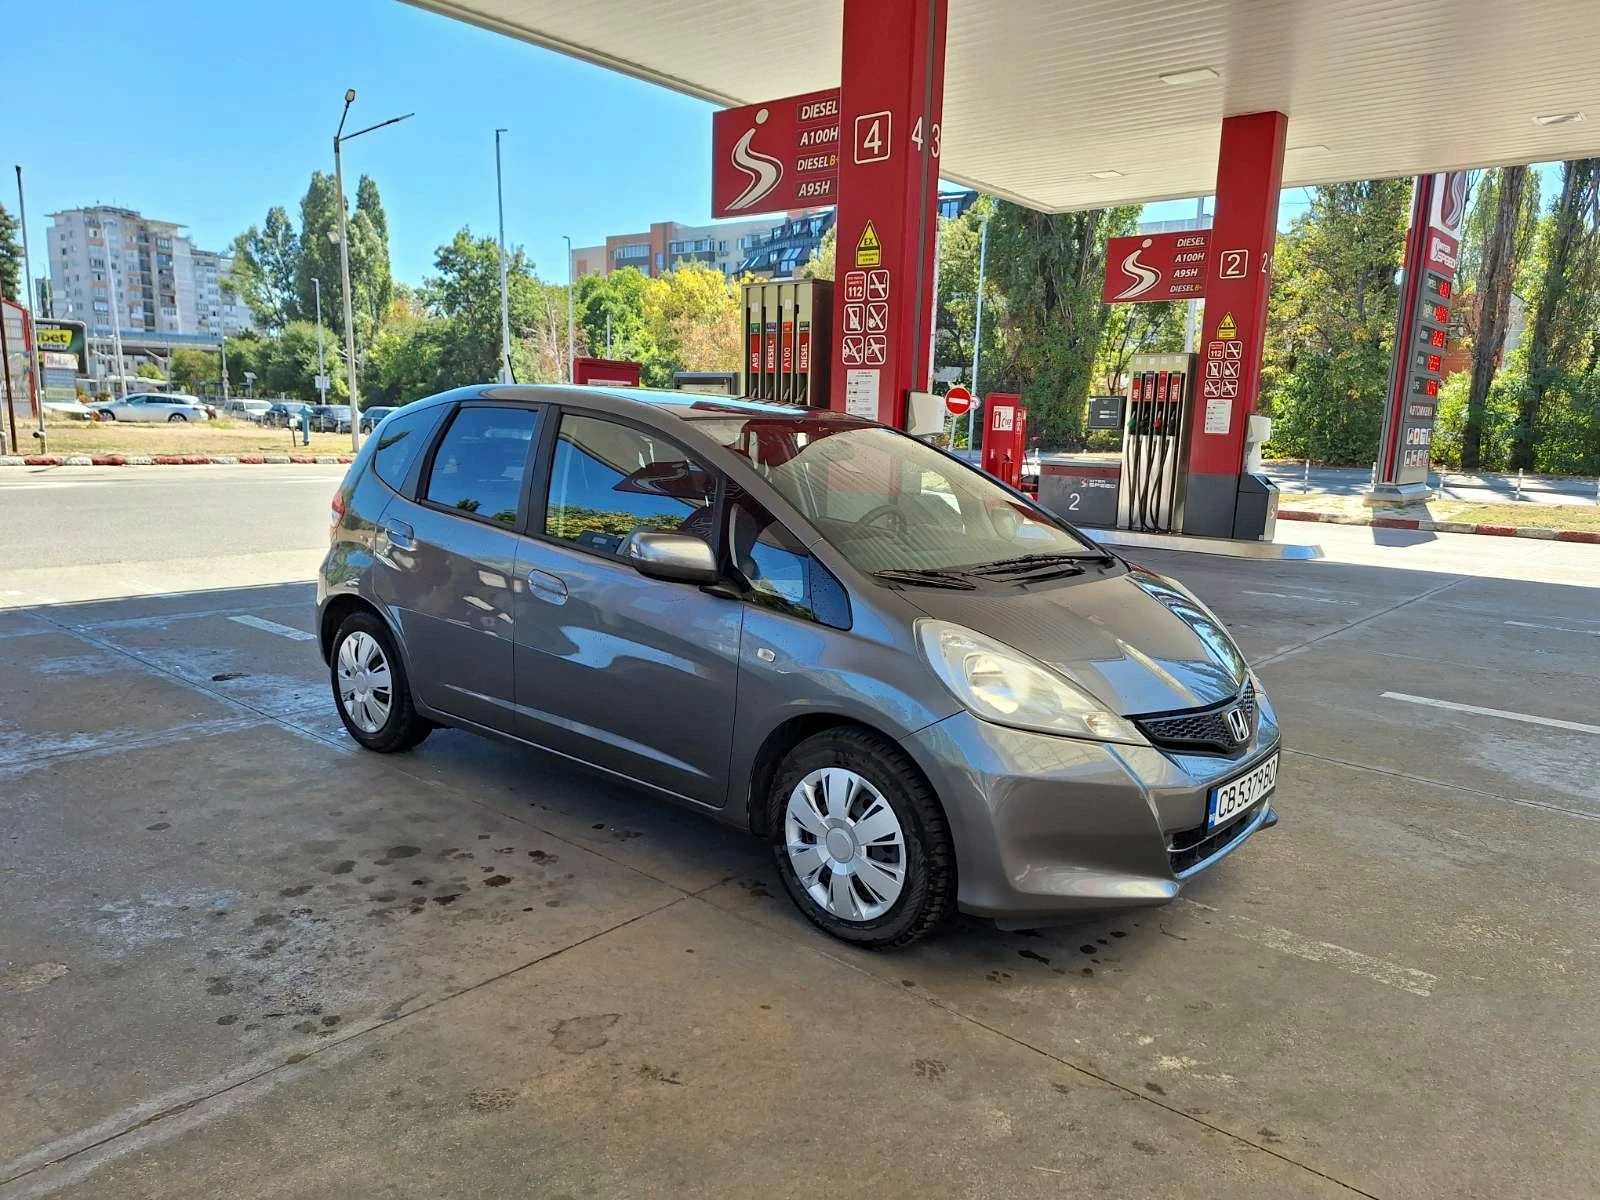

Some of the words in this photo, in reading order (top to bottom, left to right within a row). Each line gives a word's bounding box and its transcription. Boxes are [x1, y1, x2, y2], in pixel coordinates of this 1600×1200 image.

[801, 100, 838, 120] DIESEL
[800, 127, 839, 146] A100H
[863, 119, 882, 155] 4
[911, 116, 923, 151] 4
[931, 124, 941, 158] 3
[797, 156, 829, 171] DIESEL
[798, 180, 830, 197] A95H
[1177, 237, 1205, 247] DIESEL
[1175, 252, 1205, 263] A100H
[1226, 253, 1241, 275] 2
[1261, 252, 1268, 273] 2
[1173, 268, 1198, 278] A95H
[848, 286, 863, 297] 112
[783, 347, 791, 368] A100
[1068, 492, 1080, 511] 2
